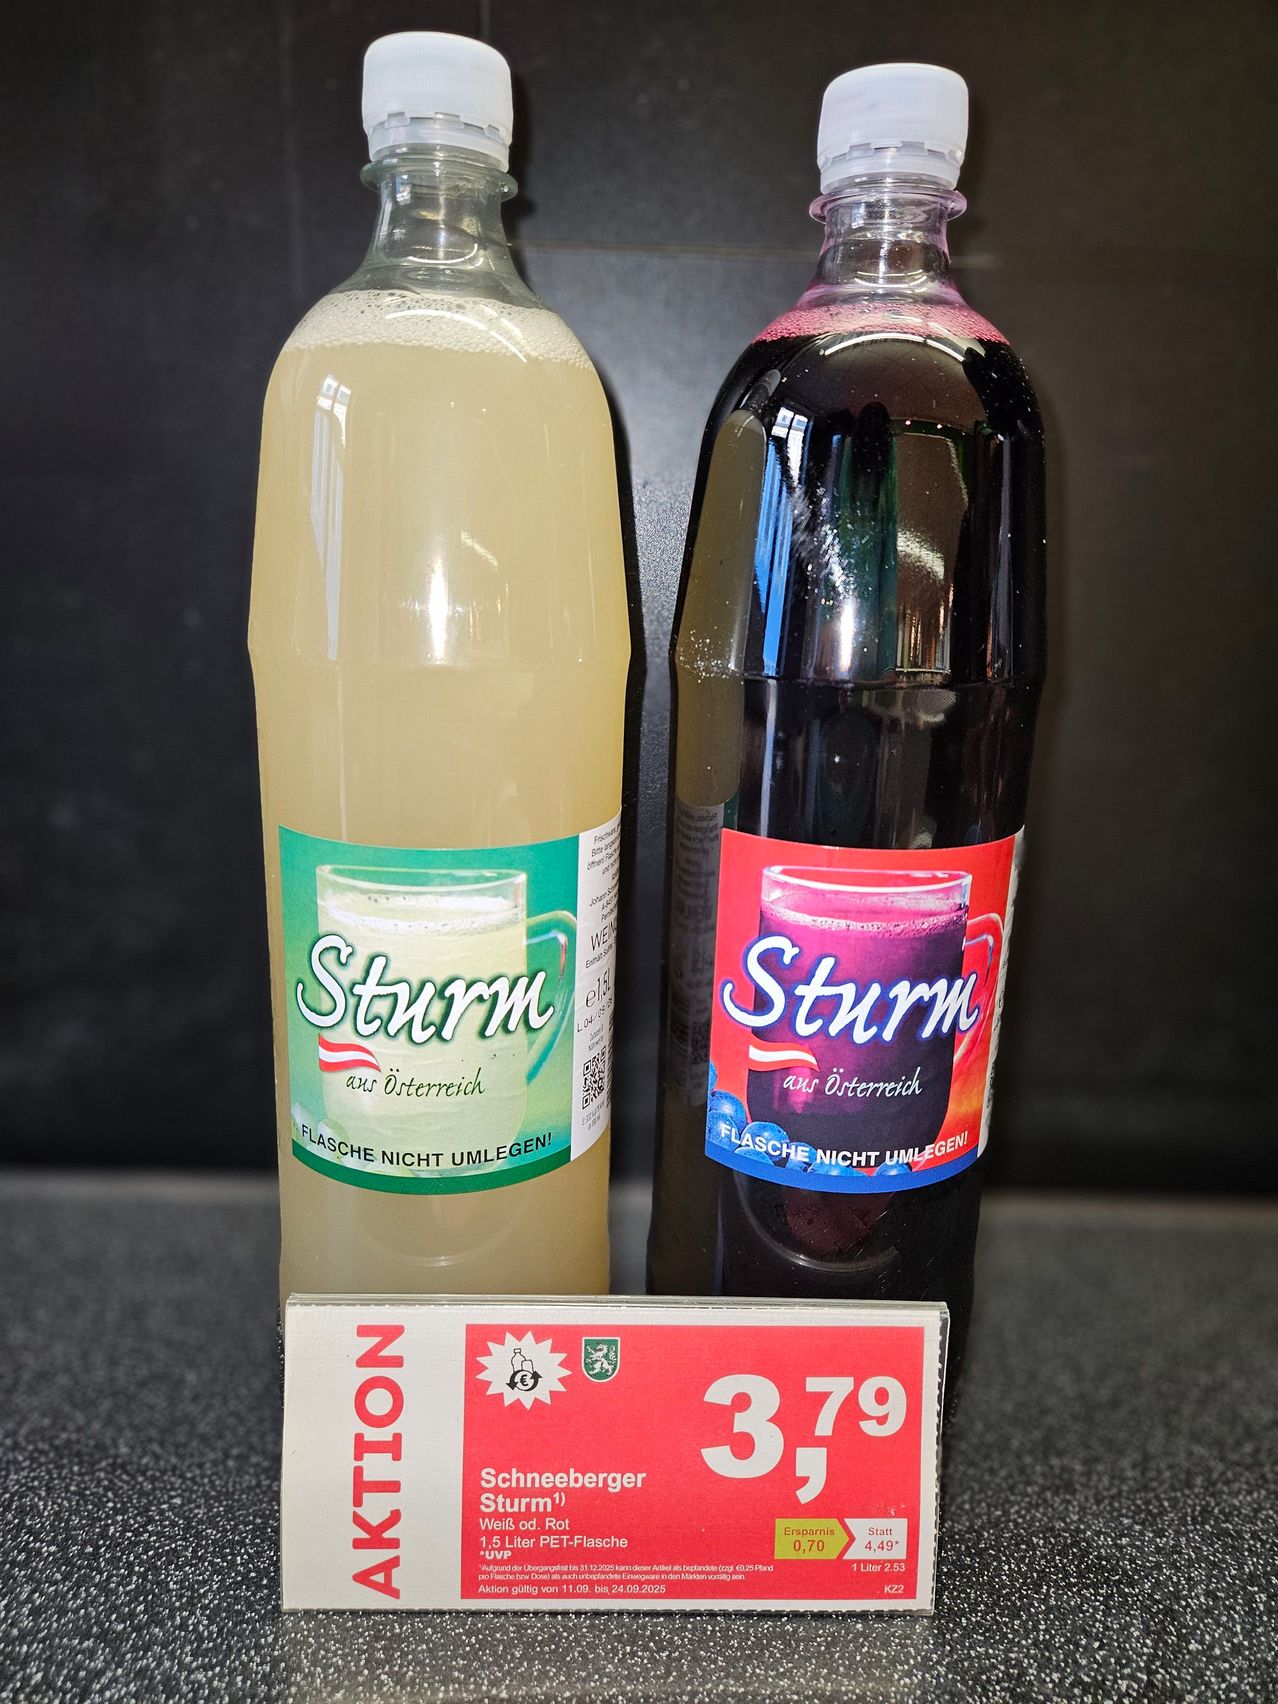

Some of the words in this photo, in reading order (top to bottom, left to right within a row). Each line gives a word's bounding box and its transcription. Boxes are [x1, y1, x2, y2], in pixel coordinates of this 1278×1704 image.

[294, 933, 556, 1046] Sturm
[721, 934, 981, 1046] Sturm
[346, 1075, 378, 1094] aus
[384, 1067, 486, 1098] Österreich
[783, 1075, 819, 1095] aus
[825, 1067, 923, 1098] Österreich
[301, 1124, 376, 1163] FLASCHE
[381, 1149, 444, 1168] NICHT
[451, 1132, 553, 1167] UMLEGEN!
[720, 1123, 811, 1164] FLASCHE
[816, 1149, 881, 1168] NICHT
[885, 1131, 969, 1167] UMLEGEN!
[352, 1324, 406, 1600] AKTION
[480, 1468, 647, 1493] Schneeberger
[479, 1517, 515, 1531] Weiß
[519, 1517, 541, 1531] od.
[545, 1517, 570, 1531] Rot
[784, 1526, 835, 1538] Ersparnis
[868, 1527, 893, 1536] Statt
[480, 1536, 501, 1549] 1,5
[505, 1535, 536, 1548] Liter
[539, 1535, 629, 1549] PET-Flasche
[793, 1539, 825, 1554] 0,70
[852, 1563, 857, 1571] 1
[860, 1562, 882, 1572] Liter
[884, 1563, 906, 1572] 2.53
[478, 1584, 509, 1593] Aktion
[512, 1584, 538, 1595] gültig
[562, 1584, 591, 1593] 11.09.
[594, 1584, 609, 1593] bis
[611, 1584, 667, 1594] 24.09.2025
[884, 1584, 905, 1594] KZ2
